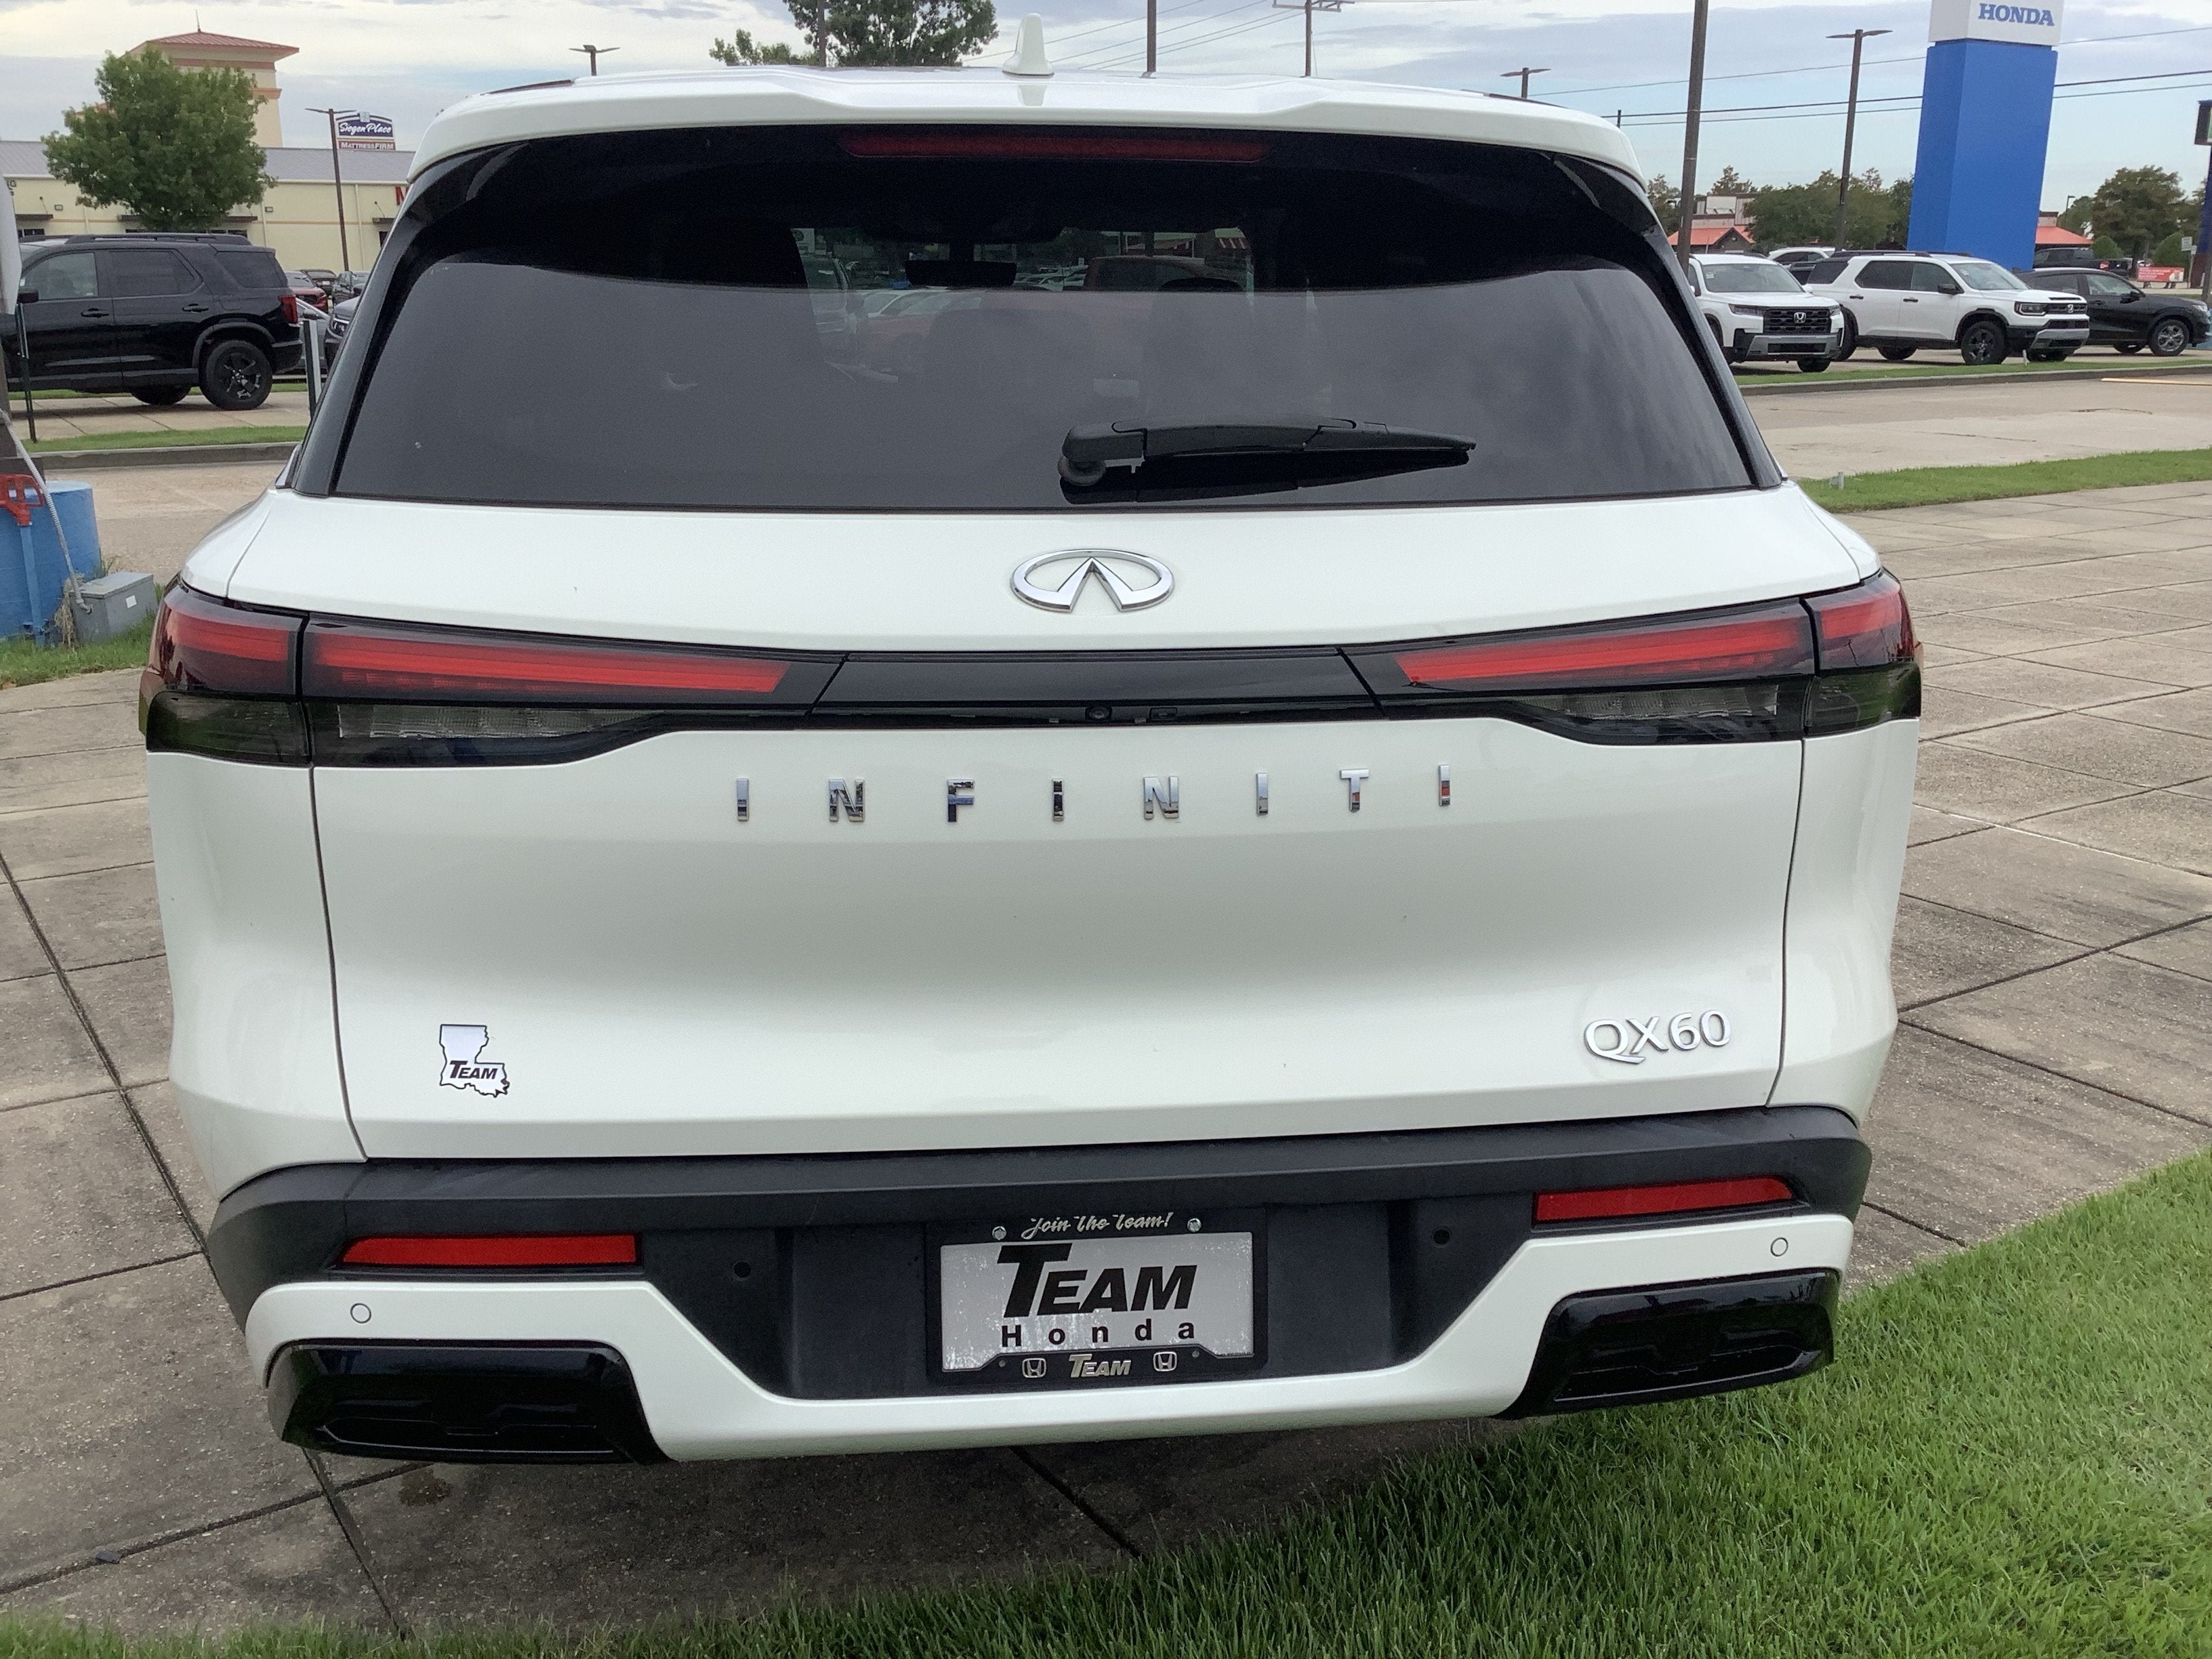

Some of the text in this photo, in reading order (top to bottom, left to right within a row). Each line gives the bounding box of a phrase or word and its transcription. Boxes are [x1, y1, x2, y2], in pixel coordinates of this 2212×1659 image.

[1978, 3, 2055, 26] HONDA
[366, 123, 392, 134] Place
[735, 764, 1452, 823] INFINITI
[1584, 1009, 1732, 1065] QX60
[449, 1060, 498, 1080] TEAM
[1021, 1217, 1071, 1240] Join
[996, 1242, 1197, 1318] TEAM
[1001, 1318, 1195, 1348] Honda
[1069, 1353, 1131, 1378] TEAM
